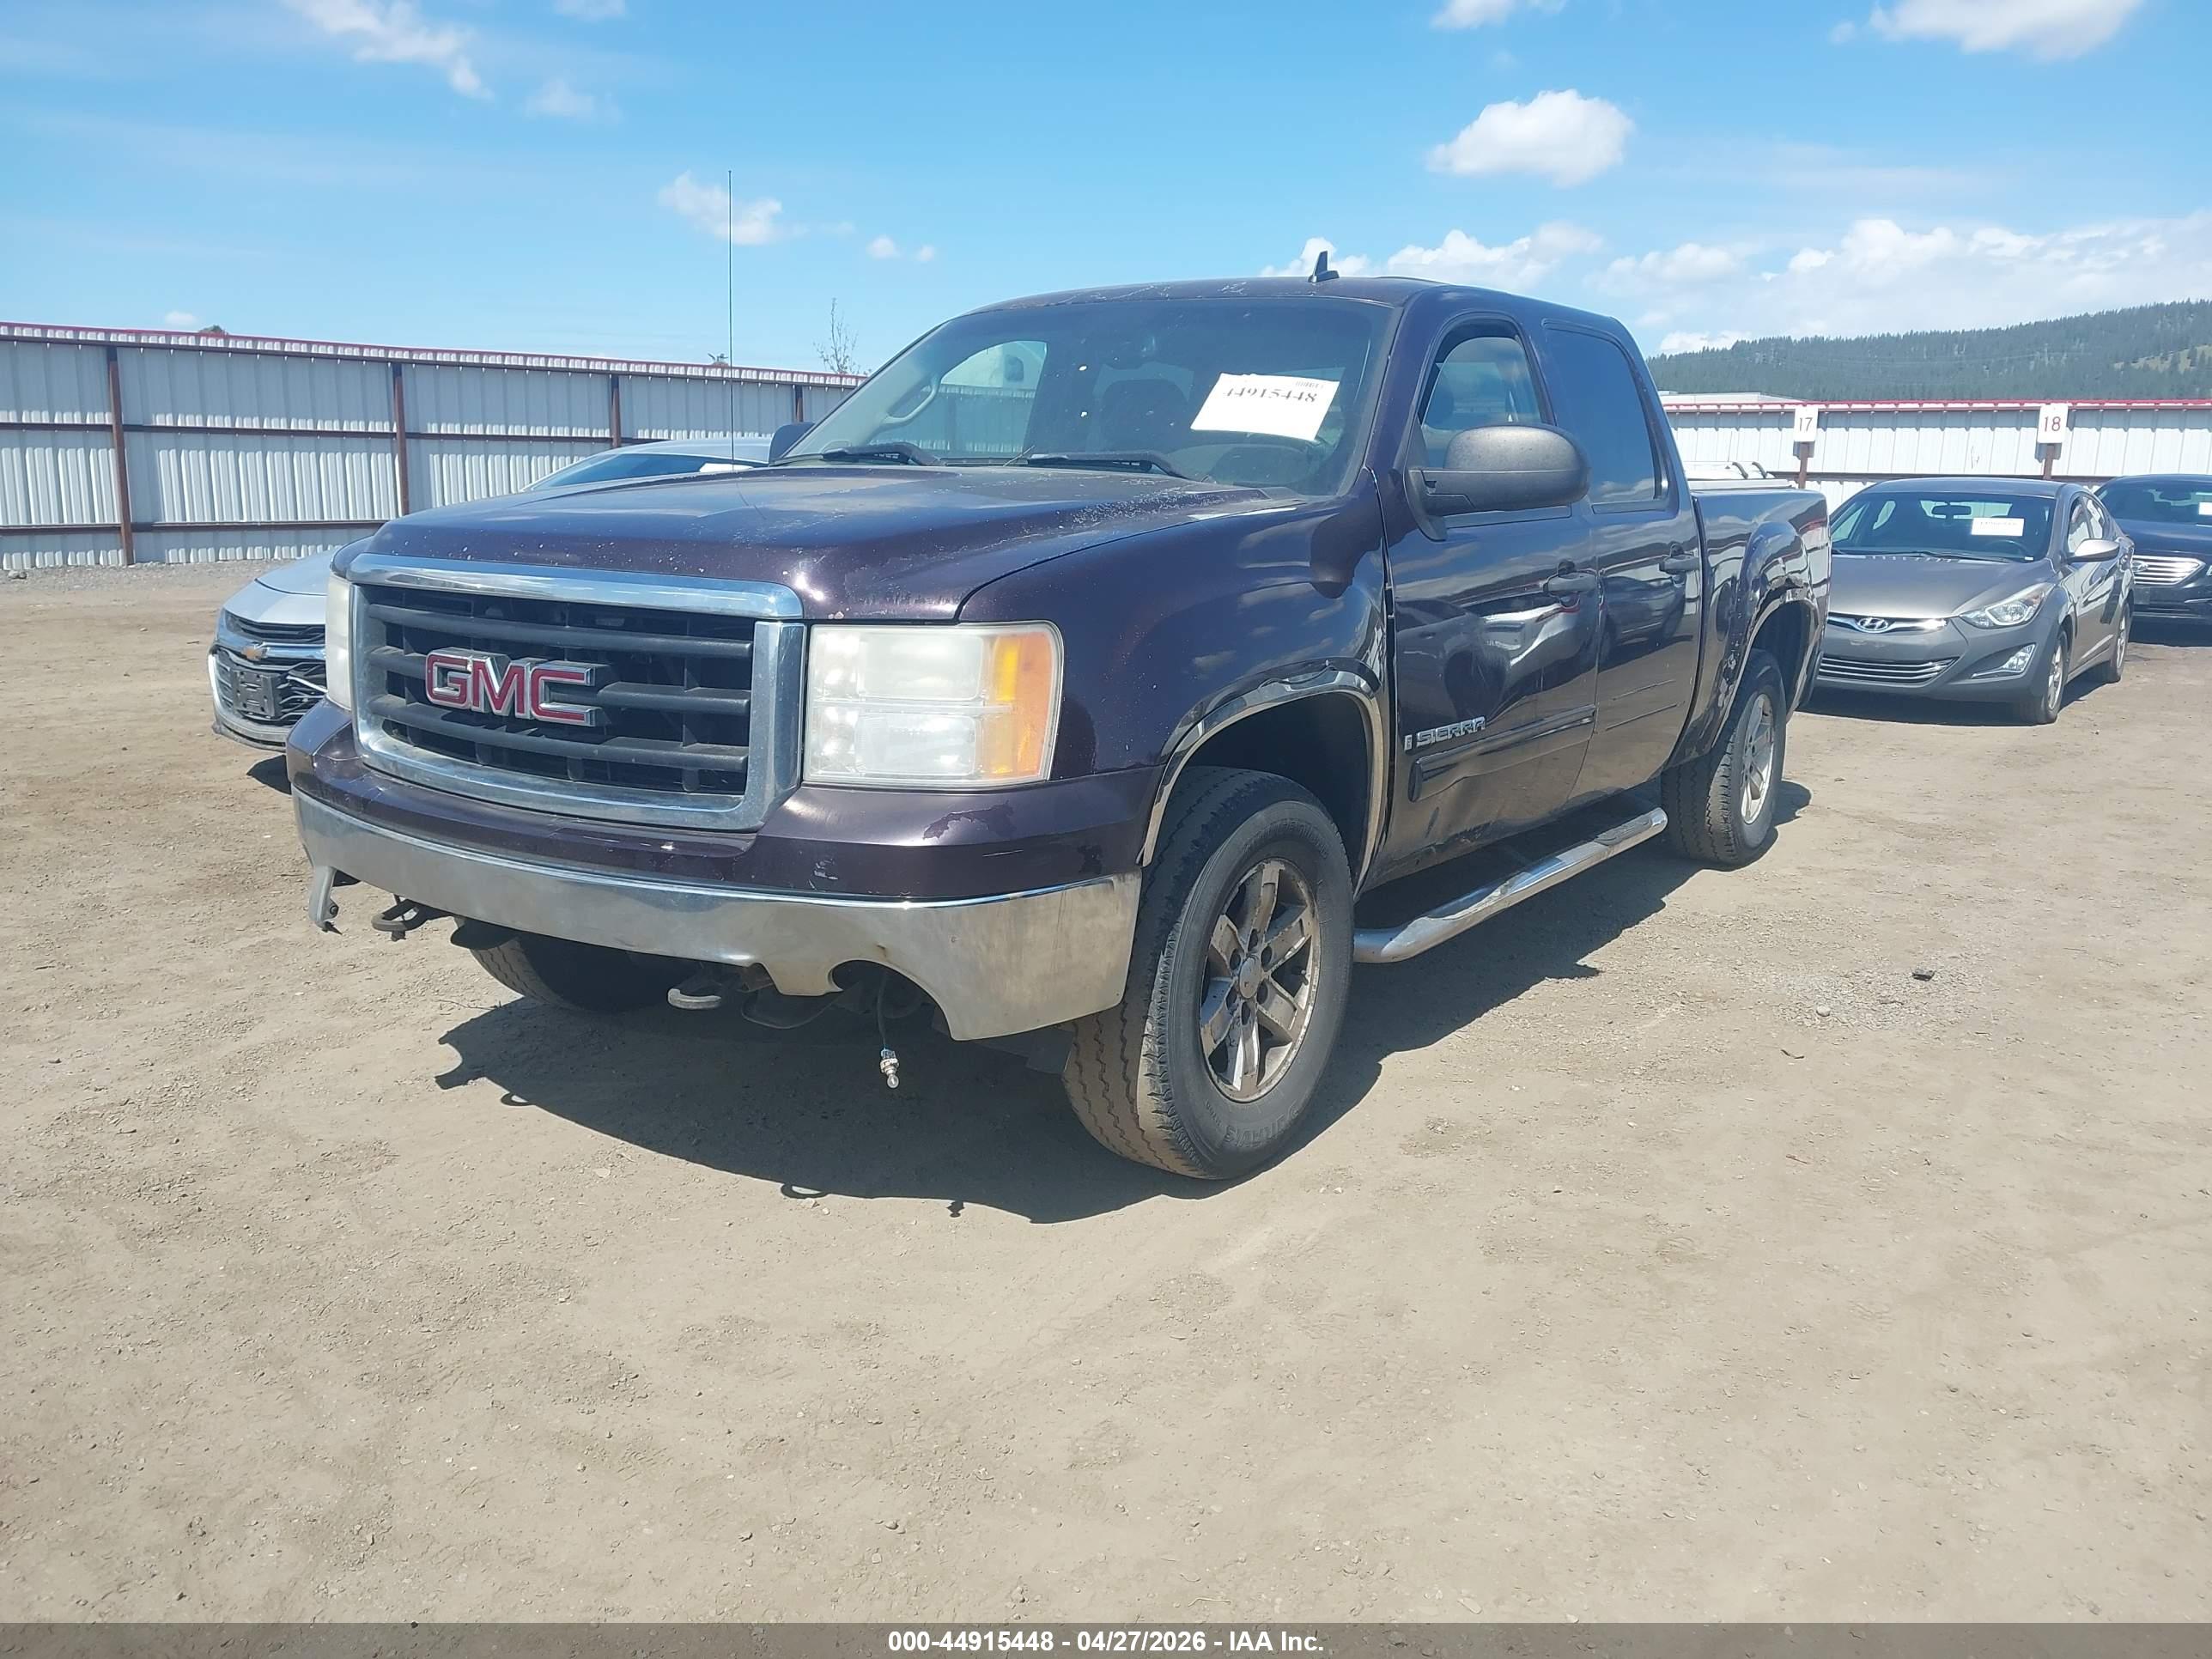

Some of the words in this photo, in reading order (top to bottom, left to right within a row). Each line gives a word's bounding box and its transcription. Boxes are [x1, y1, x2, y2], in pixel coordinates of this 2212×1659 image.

[1800, 416, 1814, 432] 17
[2045, 416, 2061, 432] 18
[425, 647, 600, 727] GMC
[1416, 716, 1486, 748] SIERRA
